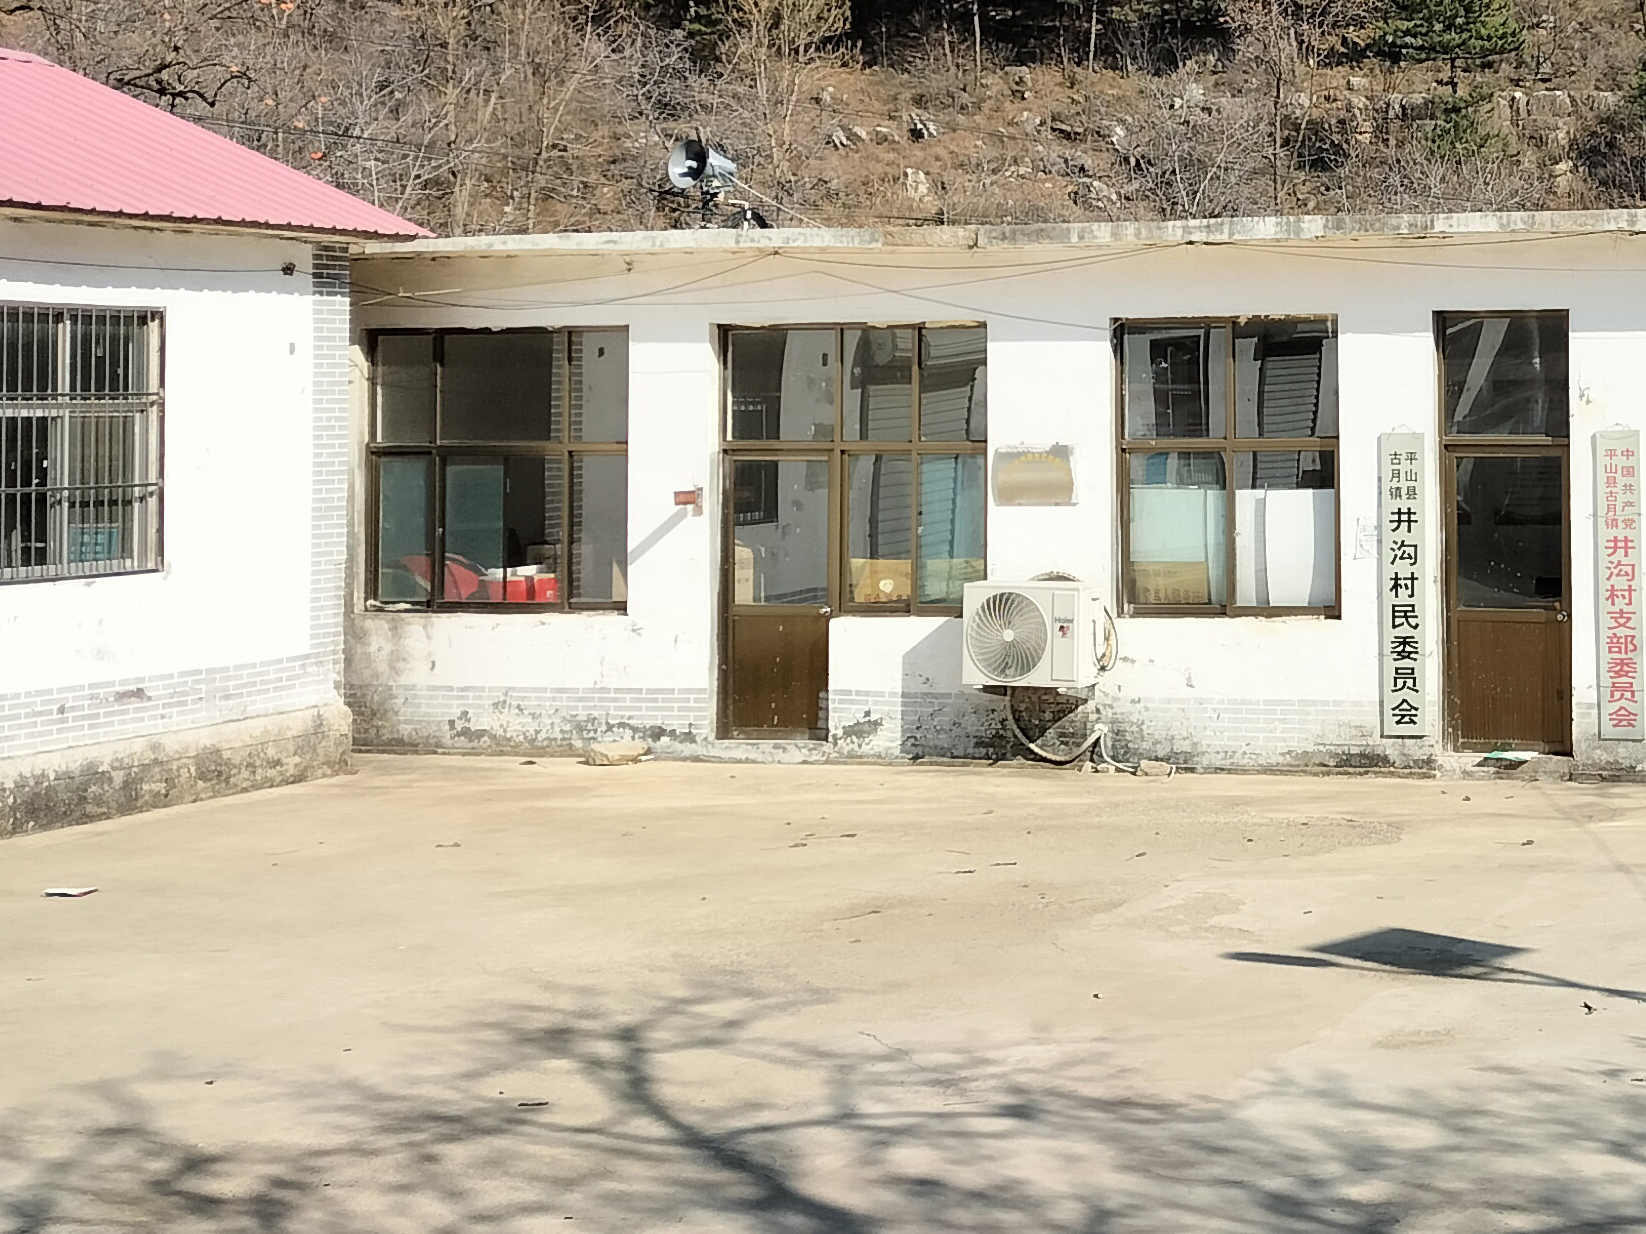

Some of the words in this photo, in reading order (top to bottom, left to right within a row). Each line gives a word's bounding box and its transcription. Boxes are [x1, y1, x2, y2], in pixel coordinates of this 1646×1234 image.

[1388, 451, 1403, 501] 古月镇
[1404, 451, 1419, 501] 平山县
[1604, 448, 1619, 530] 平山县古月镇
[1620, 448, 1636, 530] 中国共产党
[1389, 506, 1420, 726] 井沟村民委员会
[1604, 535, 1639, 729] 井沟村支部委员会
